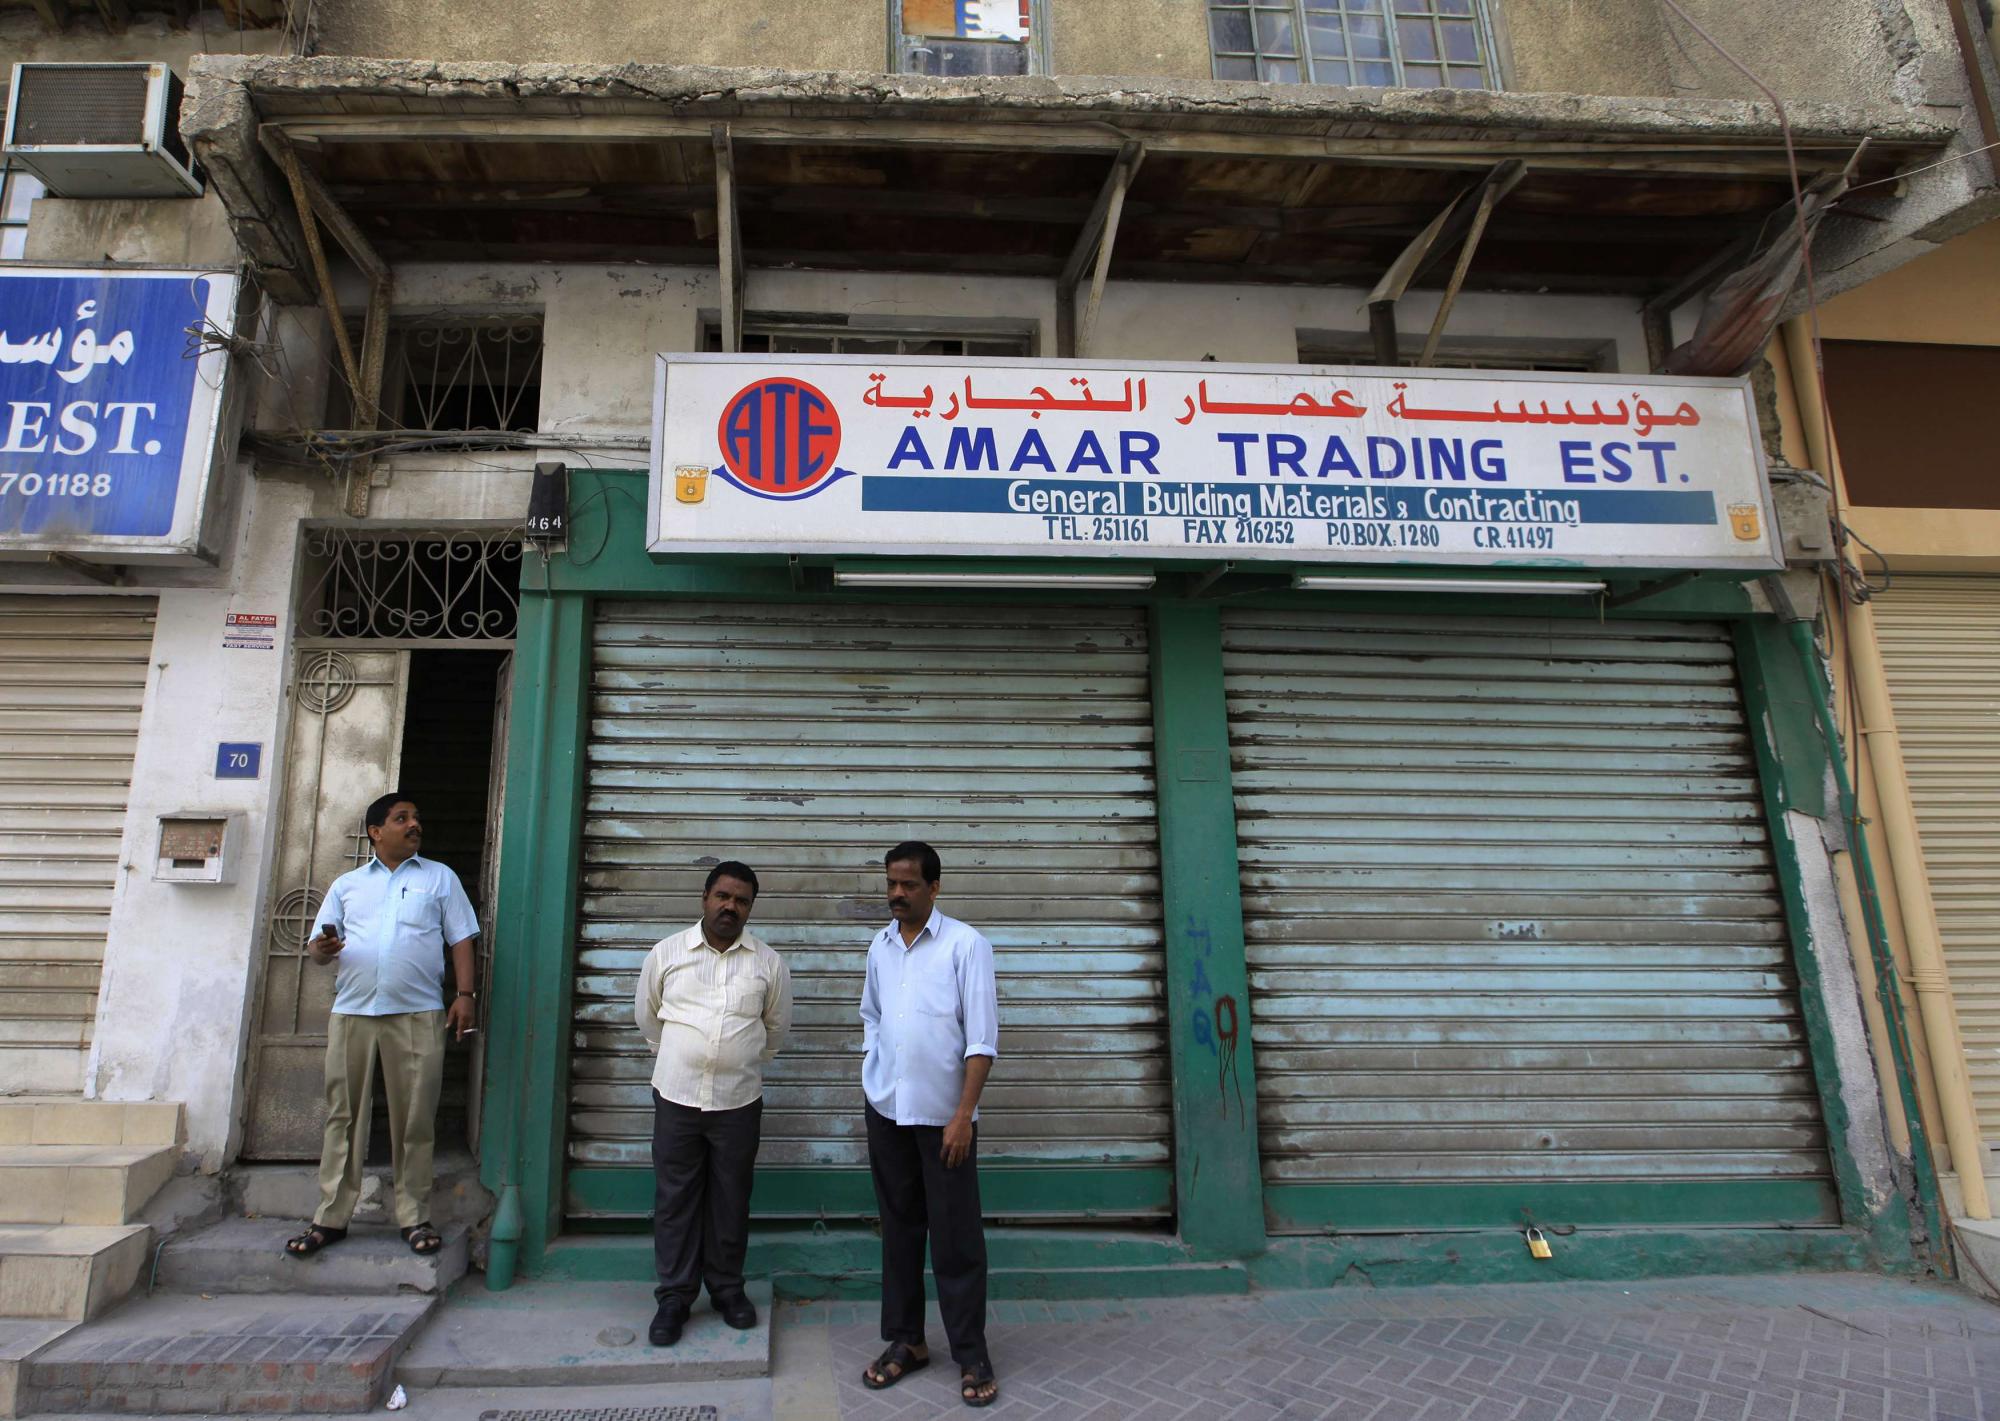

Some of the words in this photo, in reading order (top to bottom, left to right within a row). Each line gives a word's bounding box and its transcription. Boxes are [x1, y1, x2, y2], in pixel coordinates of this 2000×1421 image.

[862, 372, 1147, 421] التجارية
[1174, 378, 1368, 426] عمار
[1386, 381, 1701, 437] مؤسسة
[0, 400, 162, 456] EST.
[886, 425, 1161, 475] AMAAR
[1216, 432, 1508, 483] TRADING
[1559, 440, 1690, 484] EST.
[0, 472, 112, 498] 701188
[1007, 479, 1126, 515] General
[1142, 481, 1252, 522] Building
[1258, 484, 1388, 519] Materials
[1423, 487, 1581, 528] Contracting
[527, 515, 562, 531] 464
[1182, 518, 1228, 544] FAX
[1235, 519, 1295, 545] 216252
[229, 753, 249, 769] 70
